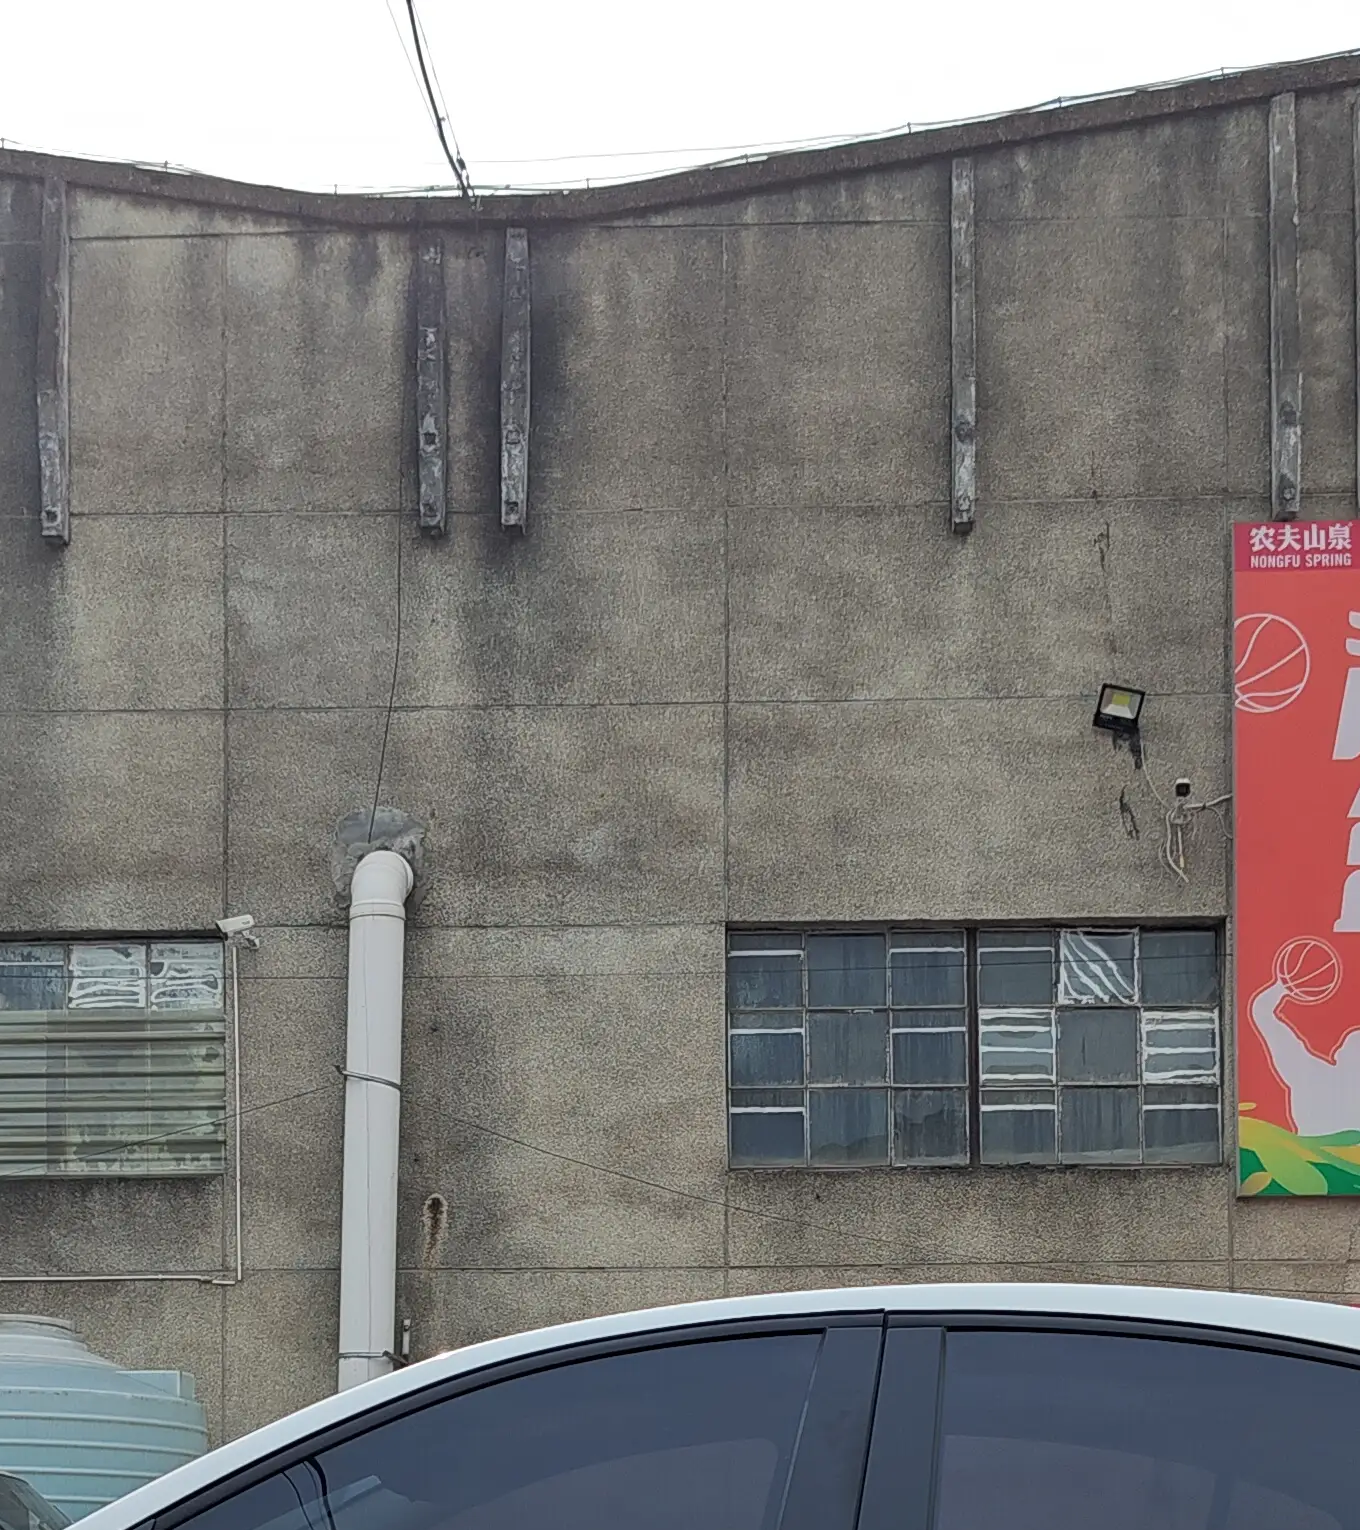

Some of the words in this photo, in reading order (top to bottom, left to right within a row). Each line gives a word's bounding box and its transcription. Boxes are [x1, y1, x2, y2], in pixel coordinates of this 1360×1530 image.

[1249, 523, 1352, 552] 农夫山泉
[1251, 555, 1301, 568] NONGFU
[1305, 552, 1352, 567] SPRING
